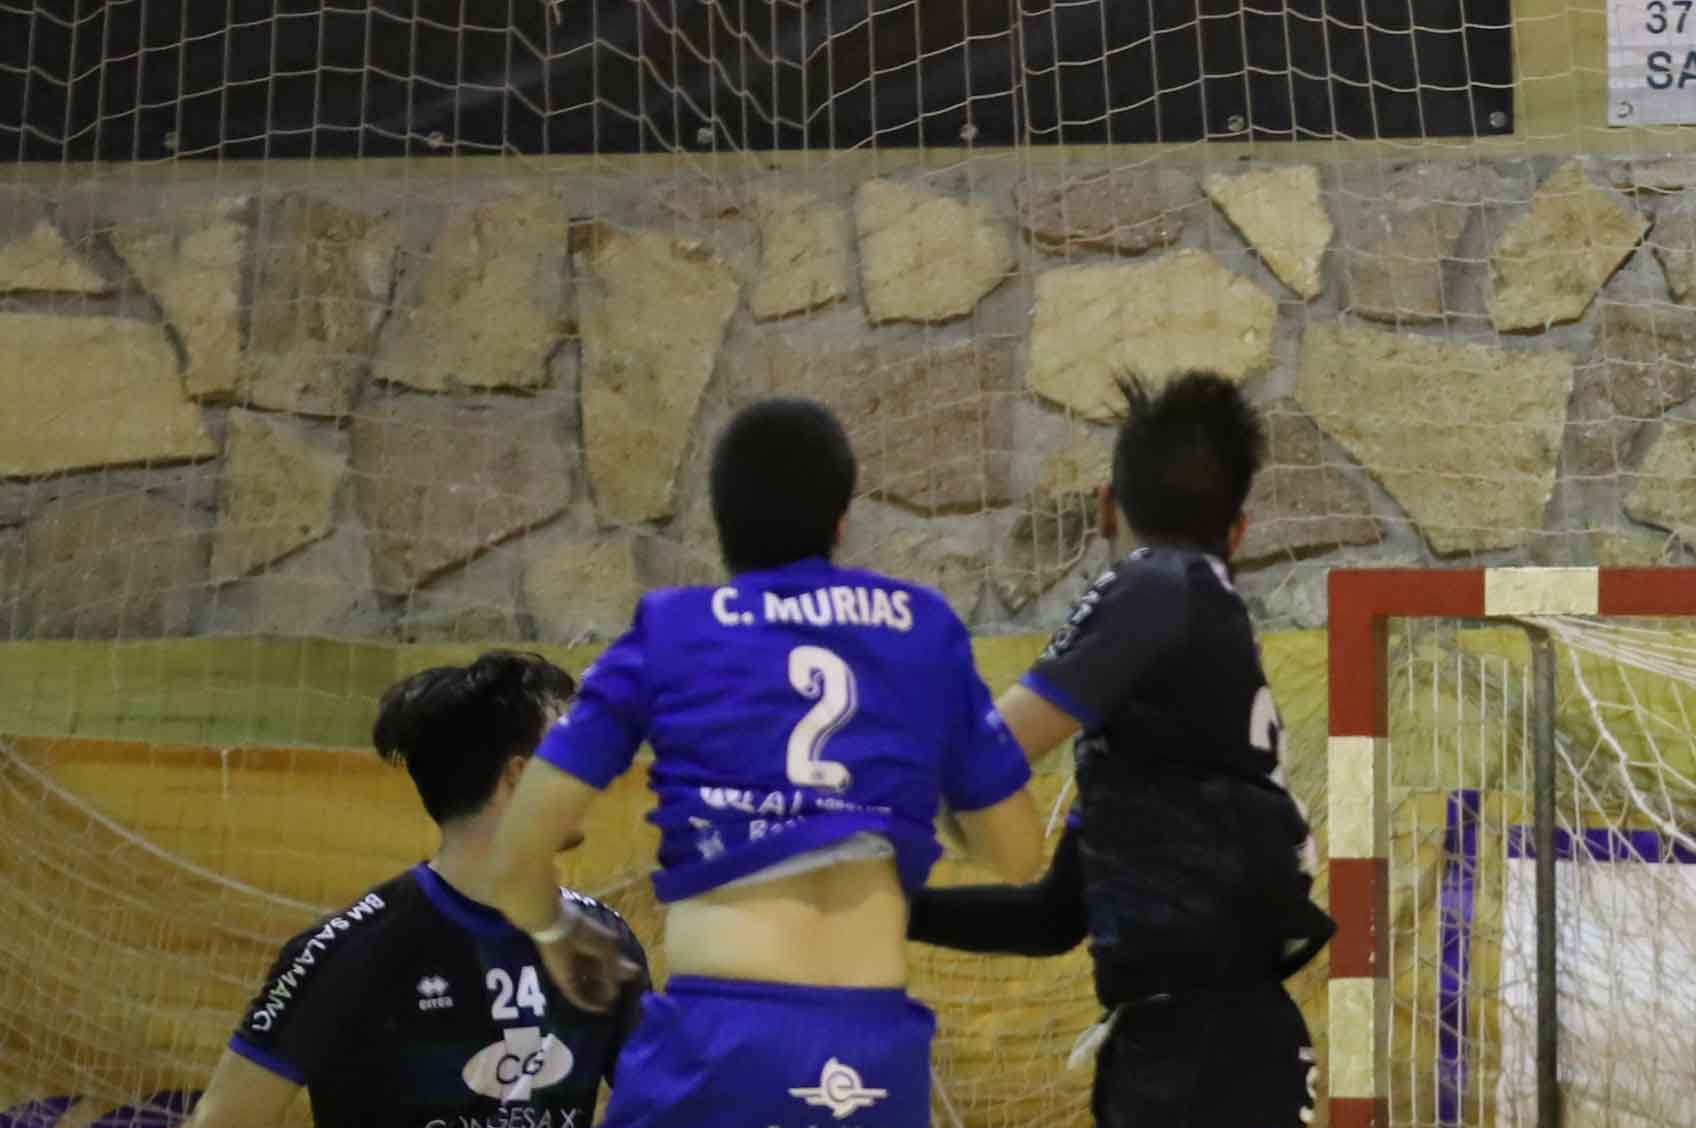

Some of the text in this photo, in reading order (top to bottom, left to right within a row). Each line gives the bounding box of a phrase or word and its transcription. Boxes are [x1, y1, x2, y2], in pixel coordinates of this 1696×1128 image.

[712, 586, 913, 632] C. MURIAS
[786, 646, 858, 791] 2
[347, 893, 385, 921] BM
[486, 965, 547, 1020] 24
[496, 1049, 545, 1085] CG
